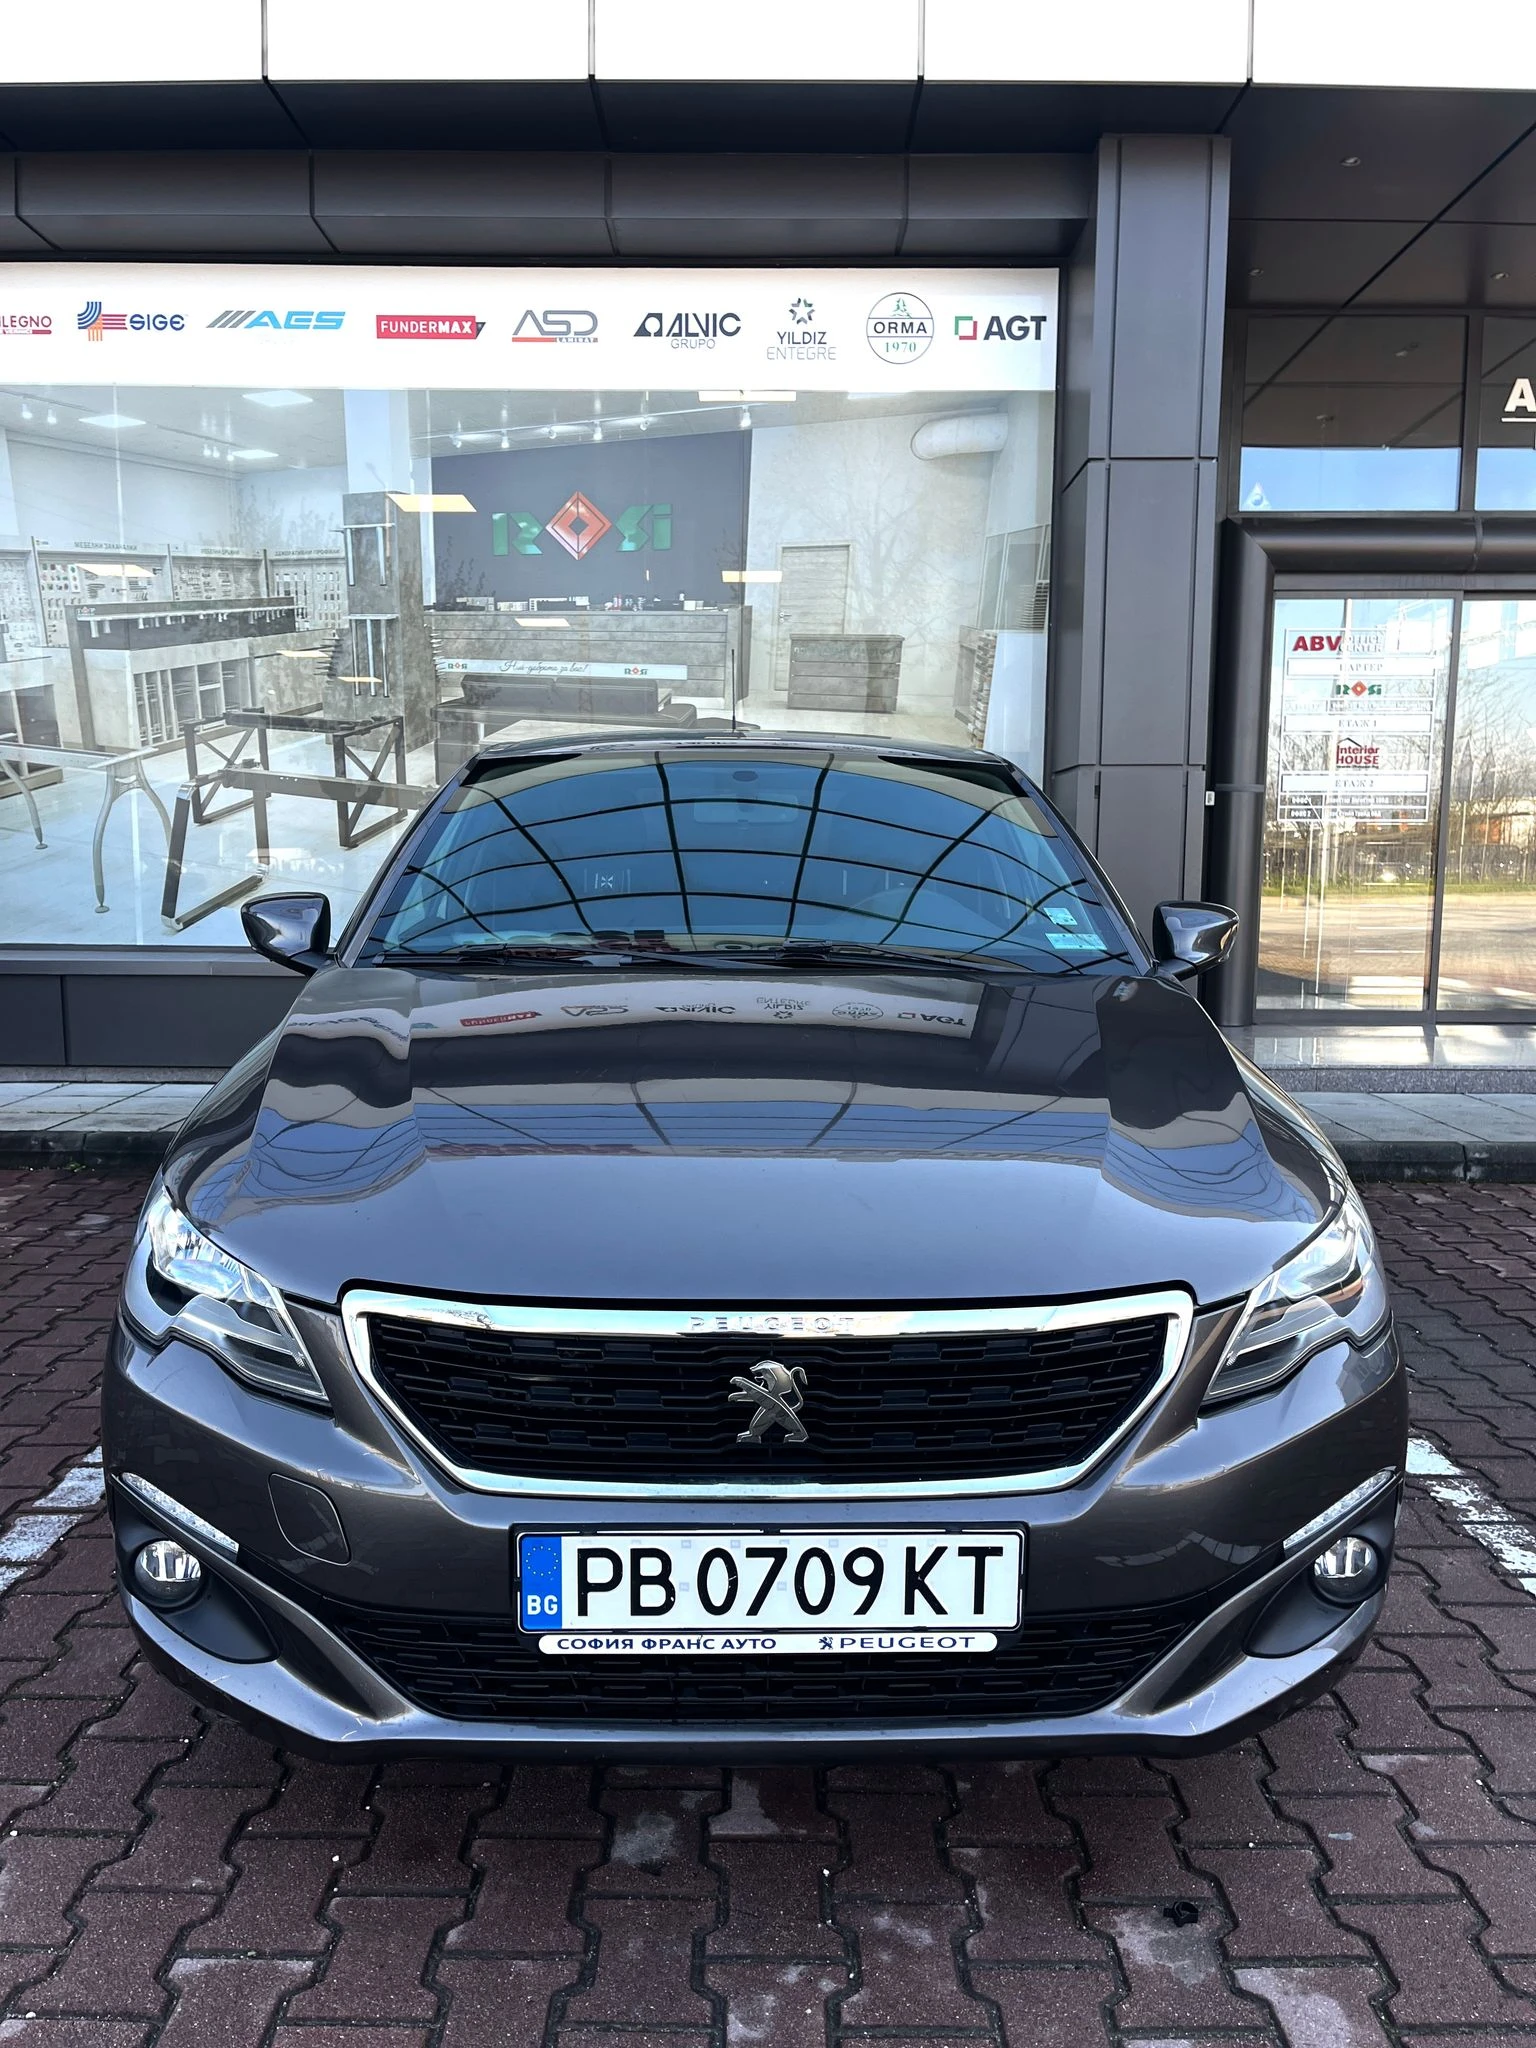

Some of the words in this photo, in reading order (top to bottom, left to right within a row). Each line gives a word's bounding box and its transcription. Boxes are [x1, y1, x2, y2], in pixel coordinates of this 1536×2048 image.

[0, 315, 52, 328] LEGNO
[129, 313, 185, 331] SIGE
[244, 310, 346, 330] AES
[381, 320, 472, 335] FUNDERMAX
[512, 309, 598, 336] ASD
[666, 312, 741, 337] ALVIC
[873, 321, 927, 335] ORMA
[983, 315, 1047, 341] AGT
[671, 338, 716, 350] GRUPO
[777, 331, 827, 345] YILDIZ
[767, 346, 837, 361] ENTEGRE
[884, 341, 917, 354] 1970
[1292, 635, 1342, 652] ABV
[1336, 744, 1380, 755] Interior
[1336, 755, 1380, 765] HOUSE
[690, 1315, 854, 1332] PEUGEOT
[577, 1546, 676, 1618] PB
[696, 1546, 885, 1617] 0709
[903, 1545, 1003, 1616] KT
[527, 1595, 558, 1616] BG
[557, 1637, 634, 1650] СОФИЯ
[641, 1636, 716, 1651] ФРАНС
[721, 1637, 777, 1650] АУТО
[839, 1636, 975, 1650] PEUGEOT
